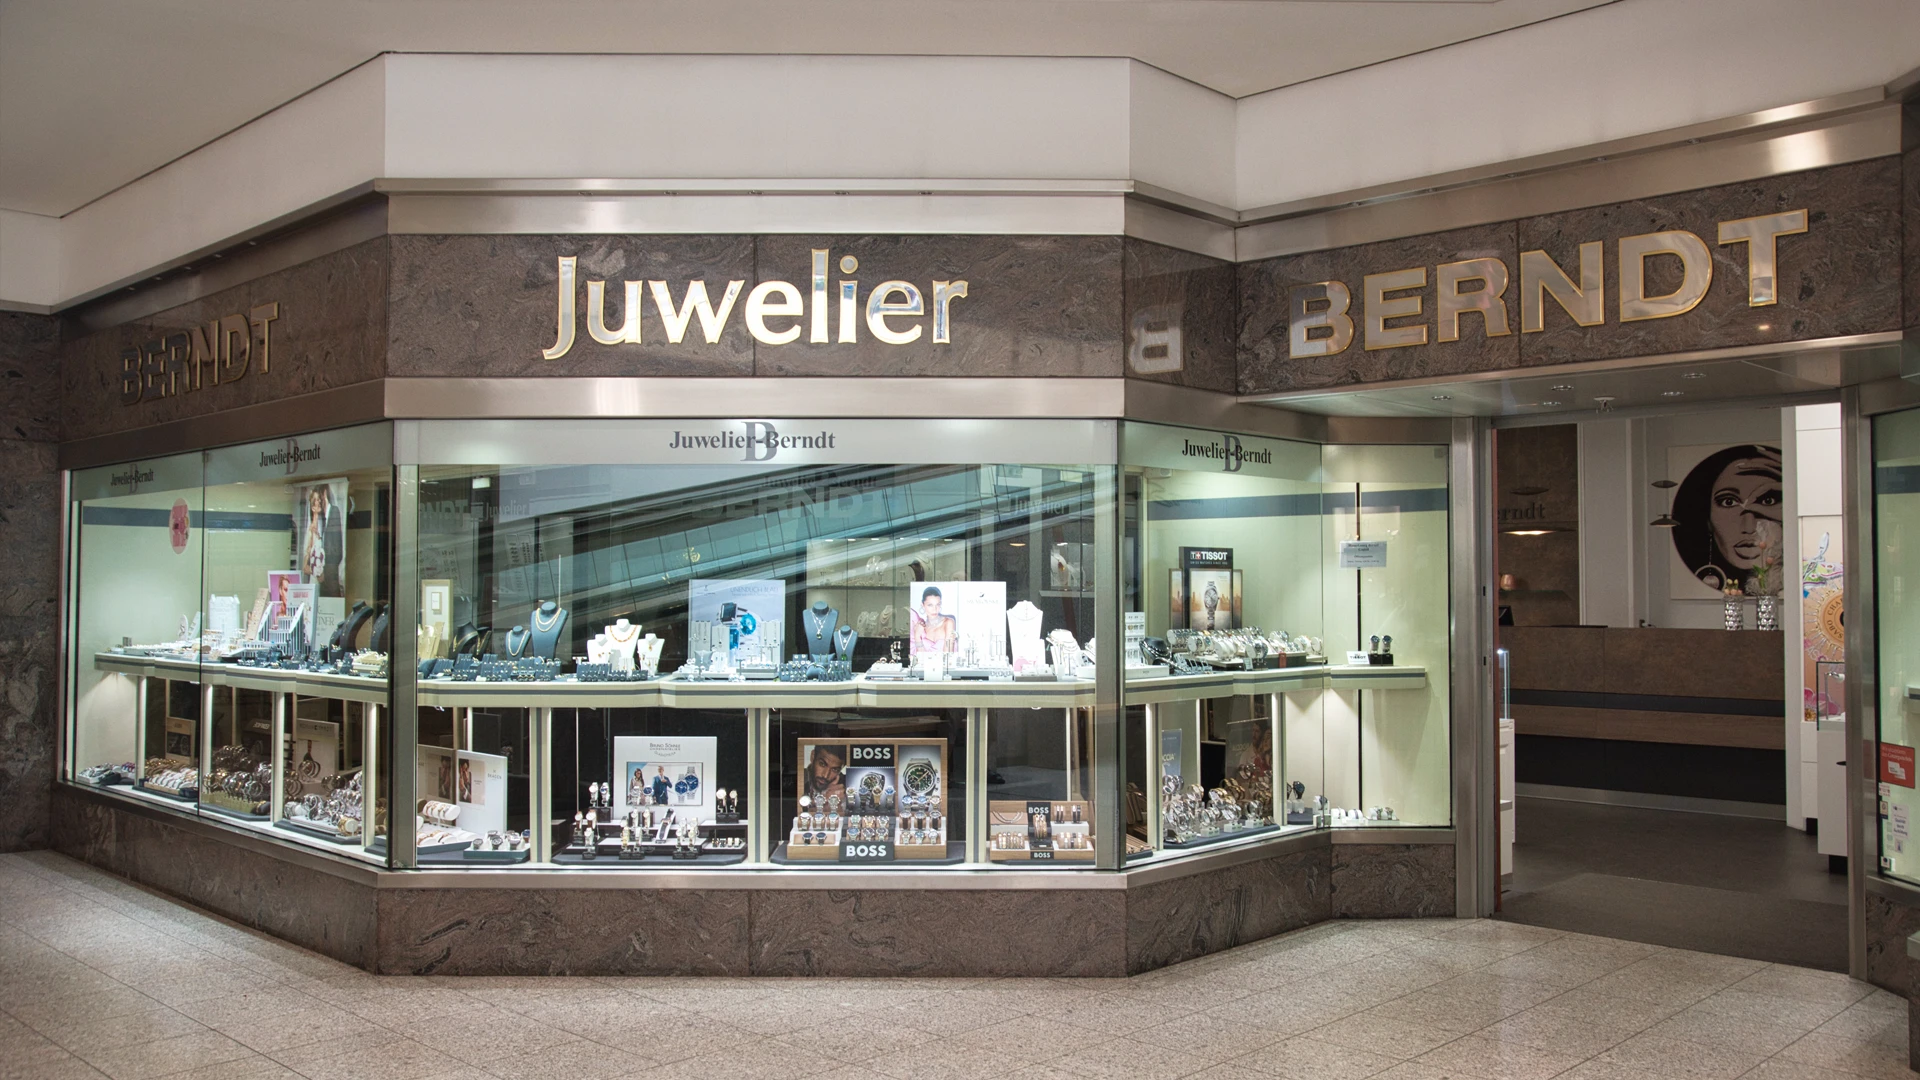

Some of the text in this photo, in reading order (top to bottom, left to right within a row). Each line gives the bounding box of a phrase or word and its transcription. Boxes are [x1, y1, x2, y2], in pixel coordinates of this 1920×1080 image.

[1288, 207, 1810, 361] BERNDT
[542, 248, 969, 360] Juwelier
[119, 301, 279, 406] BERNDT
[669, 430, 836, 452] Juwelier-Berndt
[1181, 438, 1273, 466] Juwelier-Berndt
[259, 443, 321, 468] Juwelier-Berndt
[1201, 551, 1228, 561] TISSOT
[852, 747, 892, 760] BOSS
[1028, 806, 1049, 814] BOSS
[845, 844, 887, 857] BOSS
